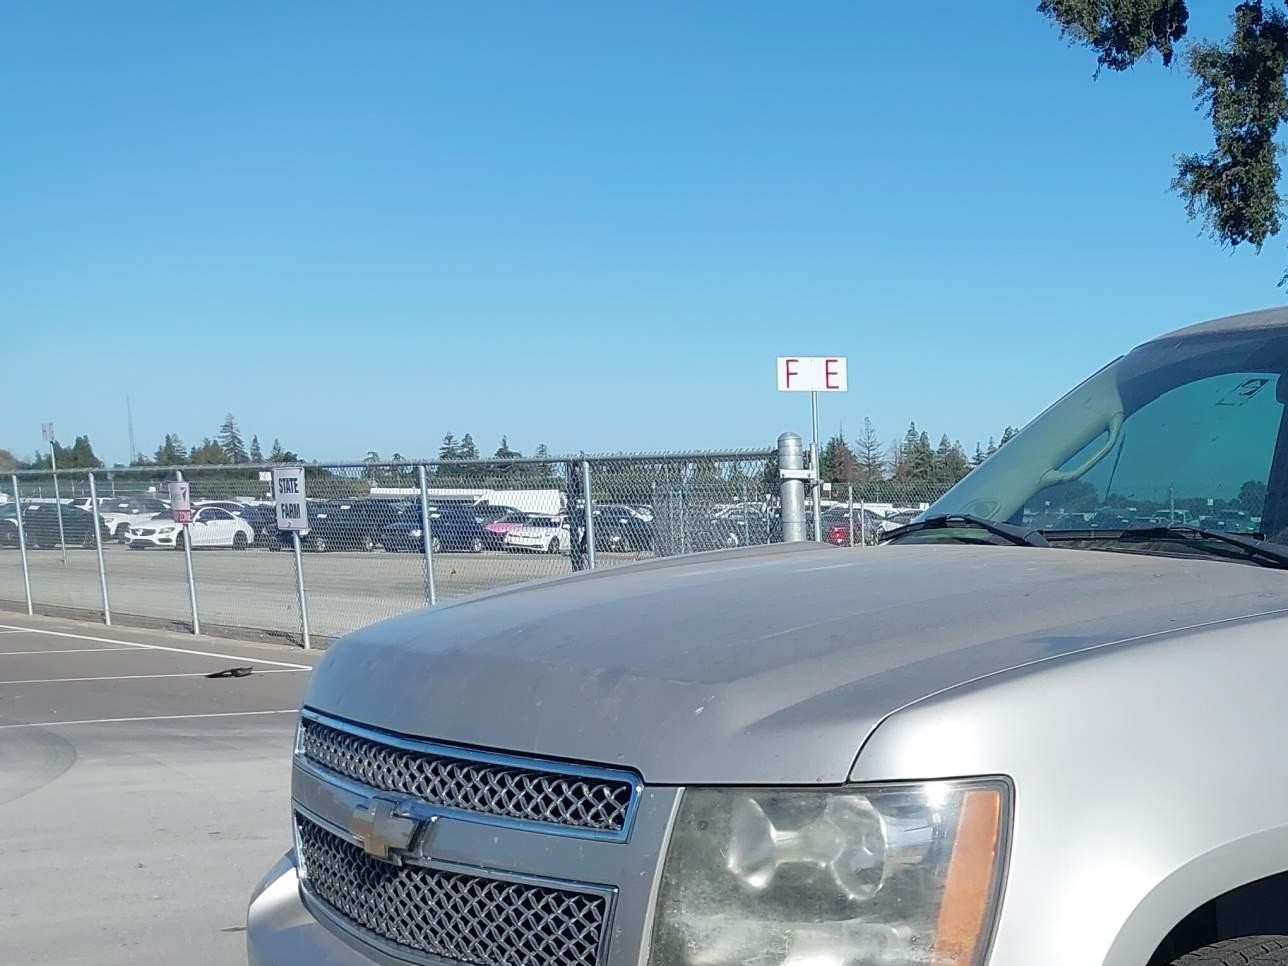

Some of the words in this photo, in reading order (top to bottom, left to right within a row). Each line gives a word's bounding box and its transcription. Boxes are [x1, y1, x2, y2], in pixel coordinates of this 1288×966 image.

[786, 359, 799, 388] F
[825, 359, 839, 389] E
[279, 477, 300, 494] STATE
[281, 503, 301, 519] FARM
